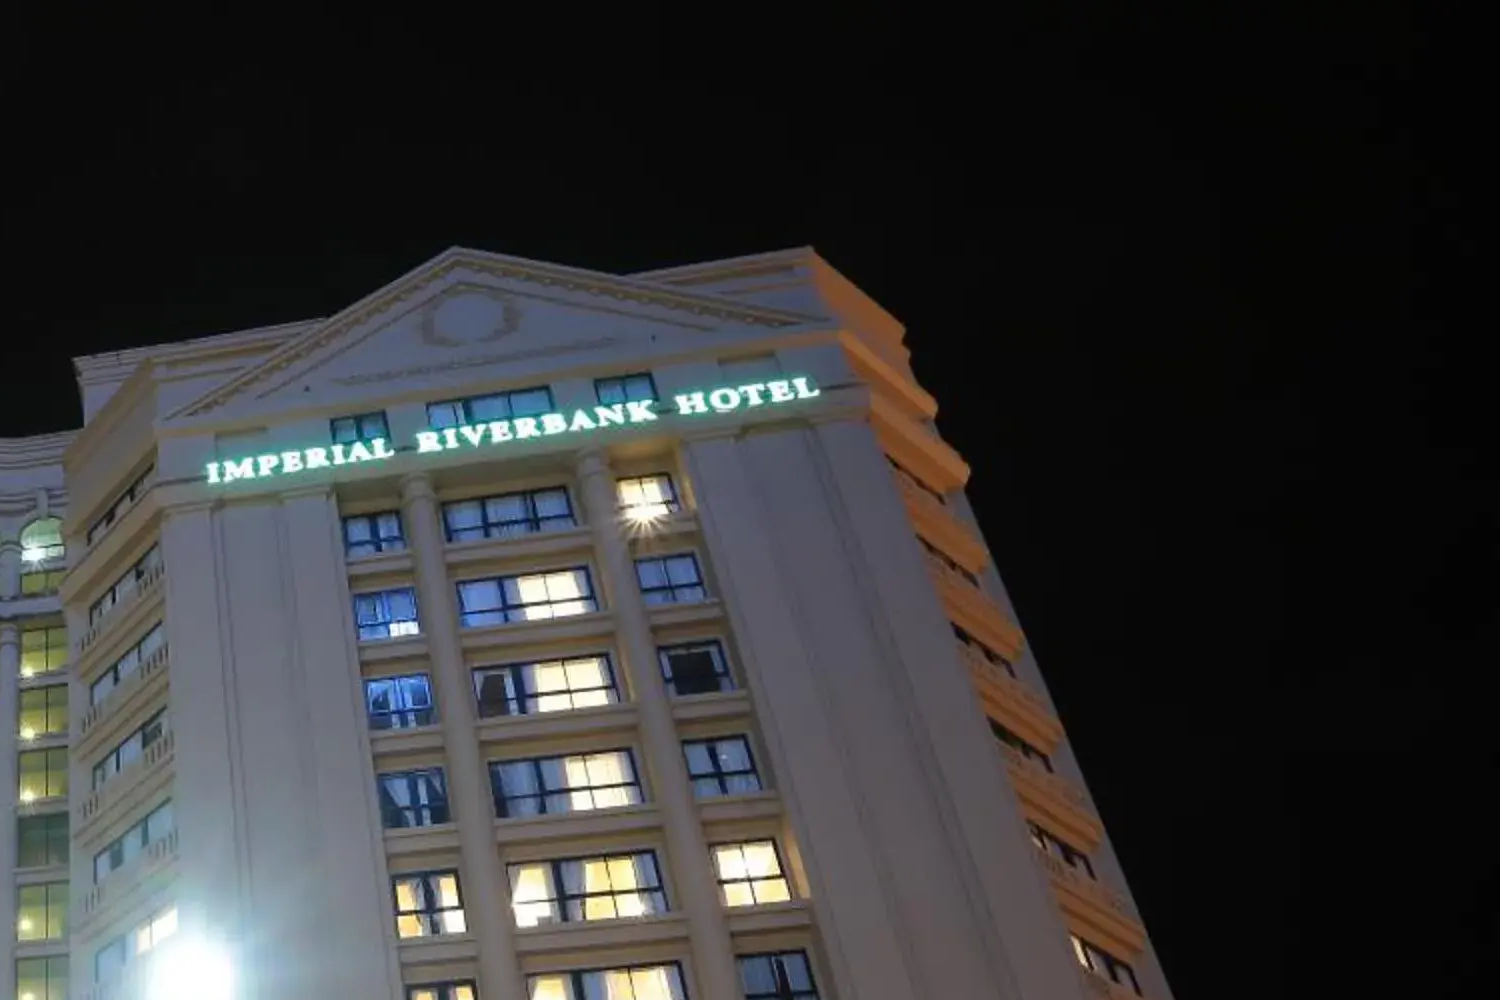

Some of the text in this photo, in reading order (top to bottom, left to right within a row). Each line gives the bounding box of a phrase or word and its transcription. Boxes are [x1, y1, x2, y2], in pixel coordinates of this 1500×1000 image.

[205, 376, 821, 485] IMPERIAL RIVERBANK HOTEL
